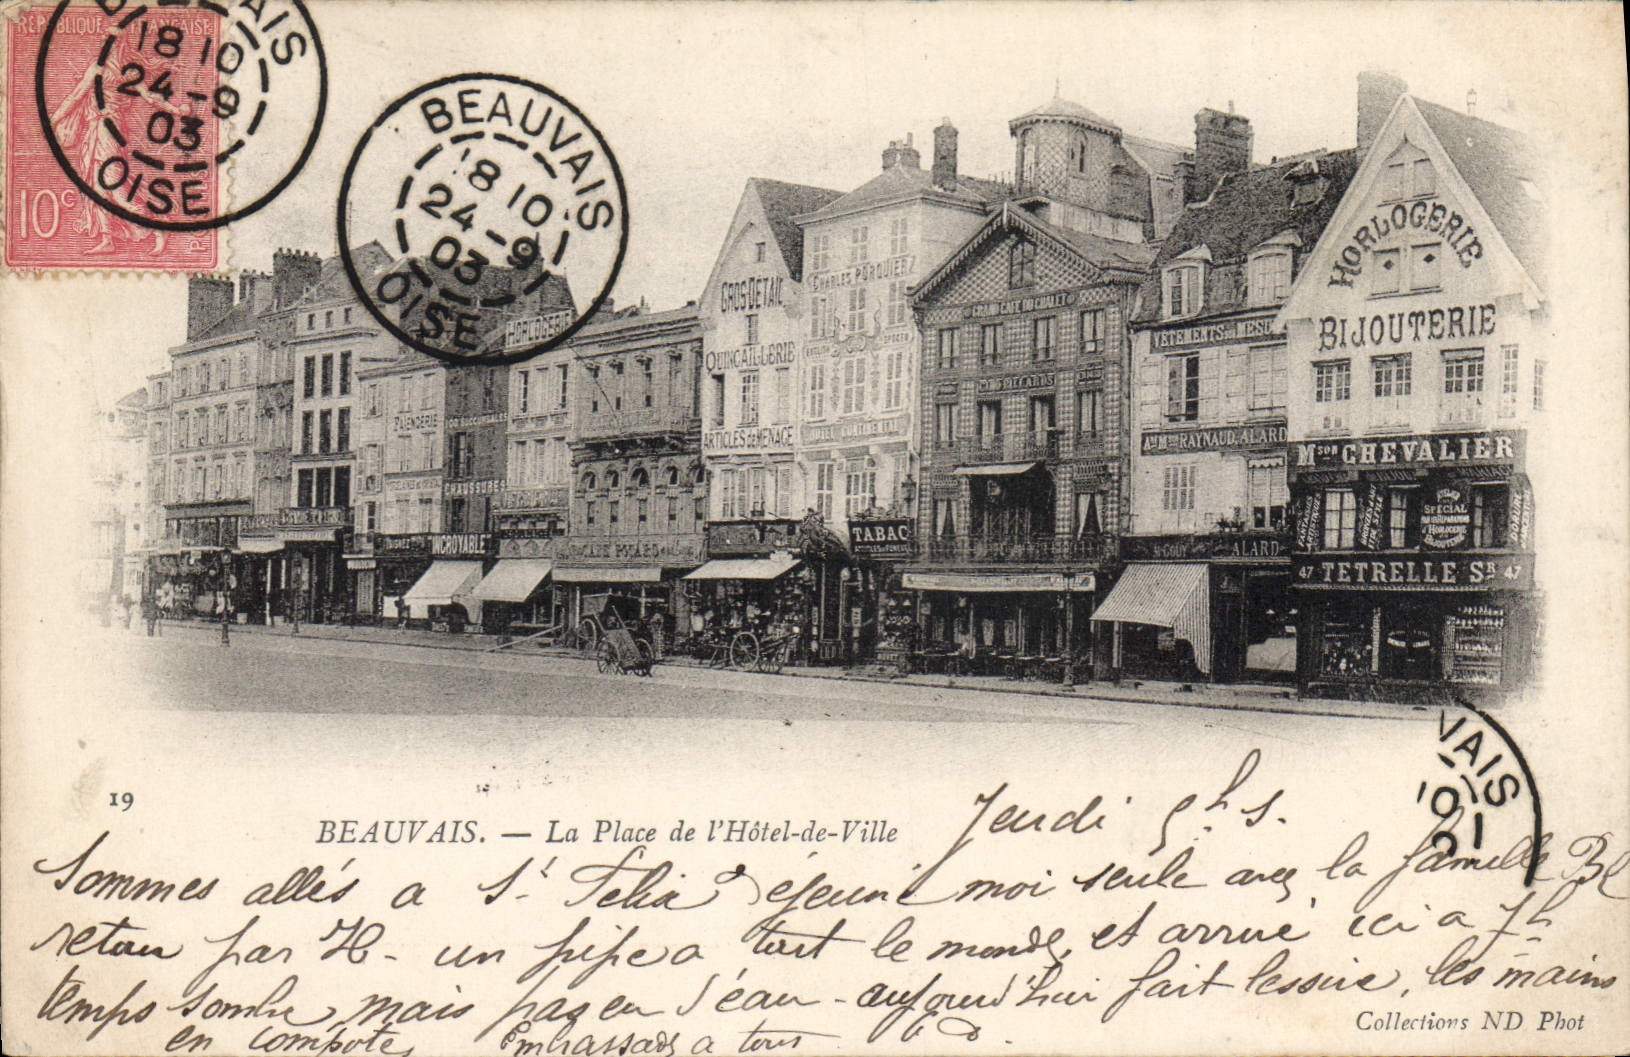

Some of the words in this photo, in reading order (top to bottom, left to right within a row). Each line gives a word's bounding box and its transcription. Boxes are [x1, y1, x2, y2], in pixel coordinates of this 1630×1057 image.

[116, 63, 175, 102] 24
[420, 88, 615, 231] BEAUVAIS
[97, 155, 212, 217] OISE
[418, 182, 478, 233] 24
[1327, 200, 1484, 289] HORLOGERIE
[376, 271, 482, 351] OISE
[1319, 303, 1496, 352] BIJOUTERIE
[705, 340, 796, 374] QUINCAILLERIE
[703, 428, 746, 450] ARTICLES
[1240, 427, 1288, 444] ALARD
[1343, 436, 1515, 466] CHEVALIER
[445, 479, 507, 496] CHAUSSURES
[852, 524, 912, 542] TABAC
[1231, 540, 1280, 557] ALARD
[1298, 565, 1315, 580] 47
[1321, 561, 1457, 584] TETRELLE
[1503, 565, 1523, 580] 47
[33, 830, 220, 903] Sommes
